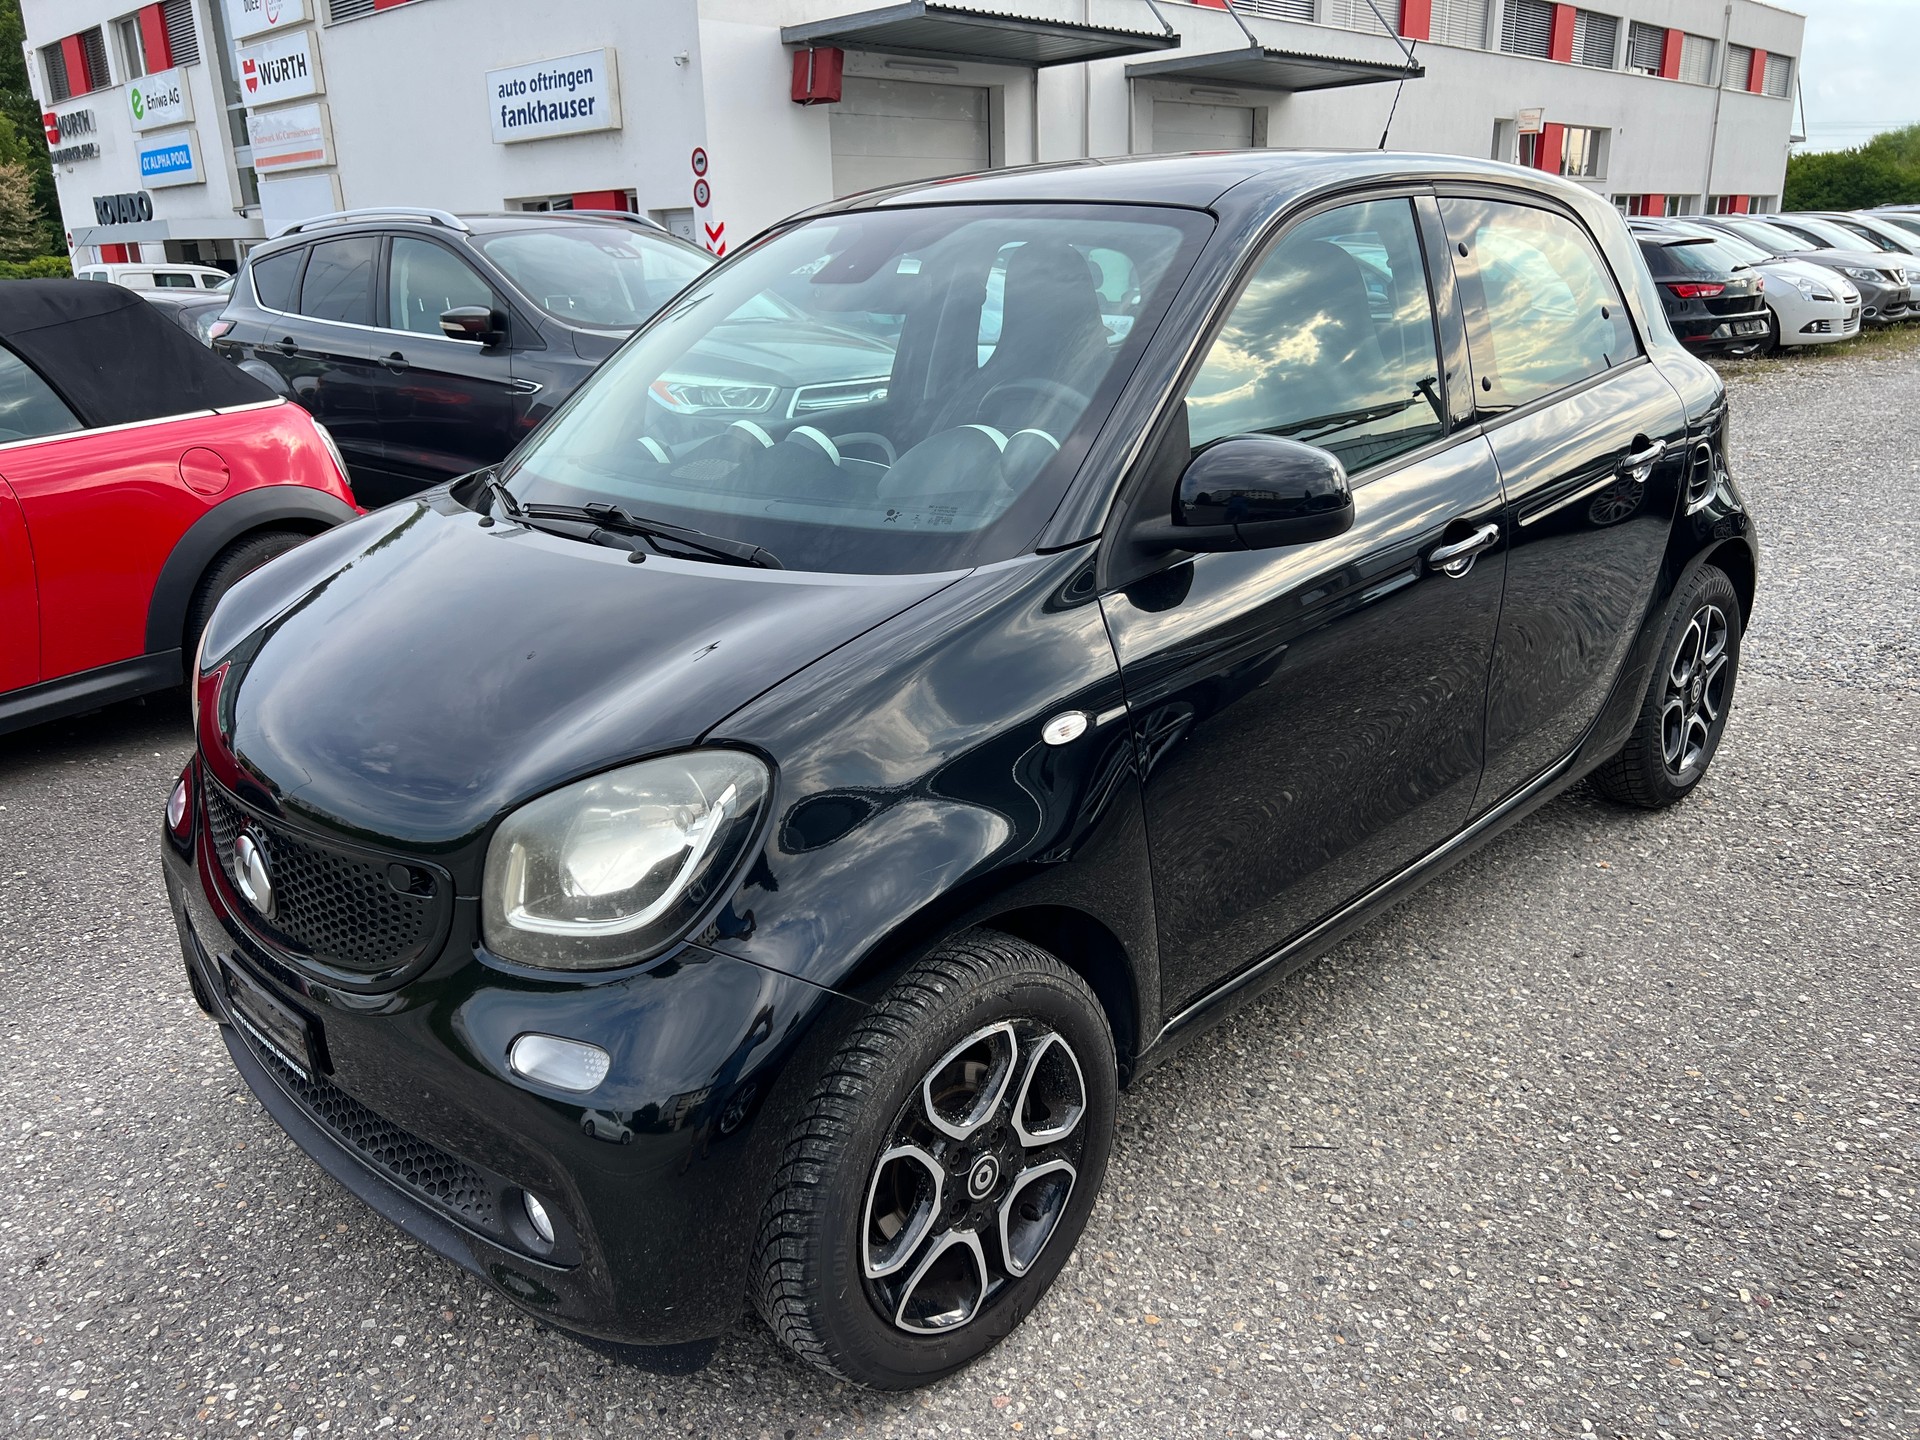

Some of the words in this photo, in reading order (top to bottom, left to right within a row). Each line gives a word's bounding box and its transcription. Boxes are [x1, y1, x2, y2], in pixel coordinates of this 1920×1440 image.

[258, 53, 307, 85] WÜRTH
[498, 79, 526, 98] auto
[530, 68, 593, 92] oftringen
[146, 92, 167, 110] Eniwa
[169, 87, 180, 106] AG
[501, 96, 595, 128] fankhauser
[57, 109, 91, 137] WÜRTH
[151, 153, 171, 170] ALPHA
[171, 150, 189, 166] POOL
[93, 191, 152, 226] ROVADO
